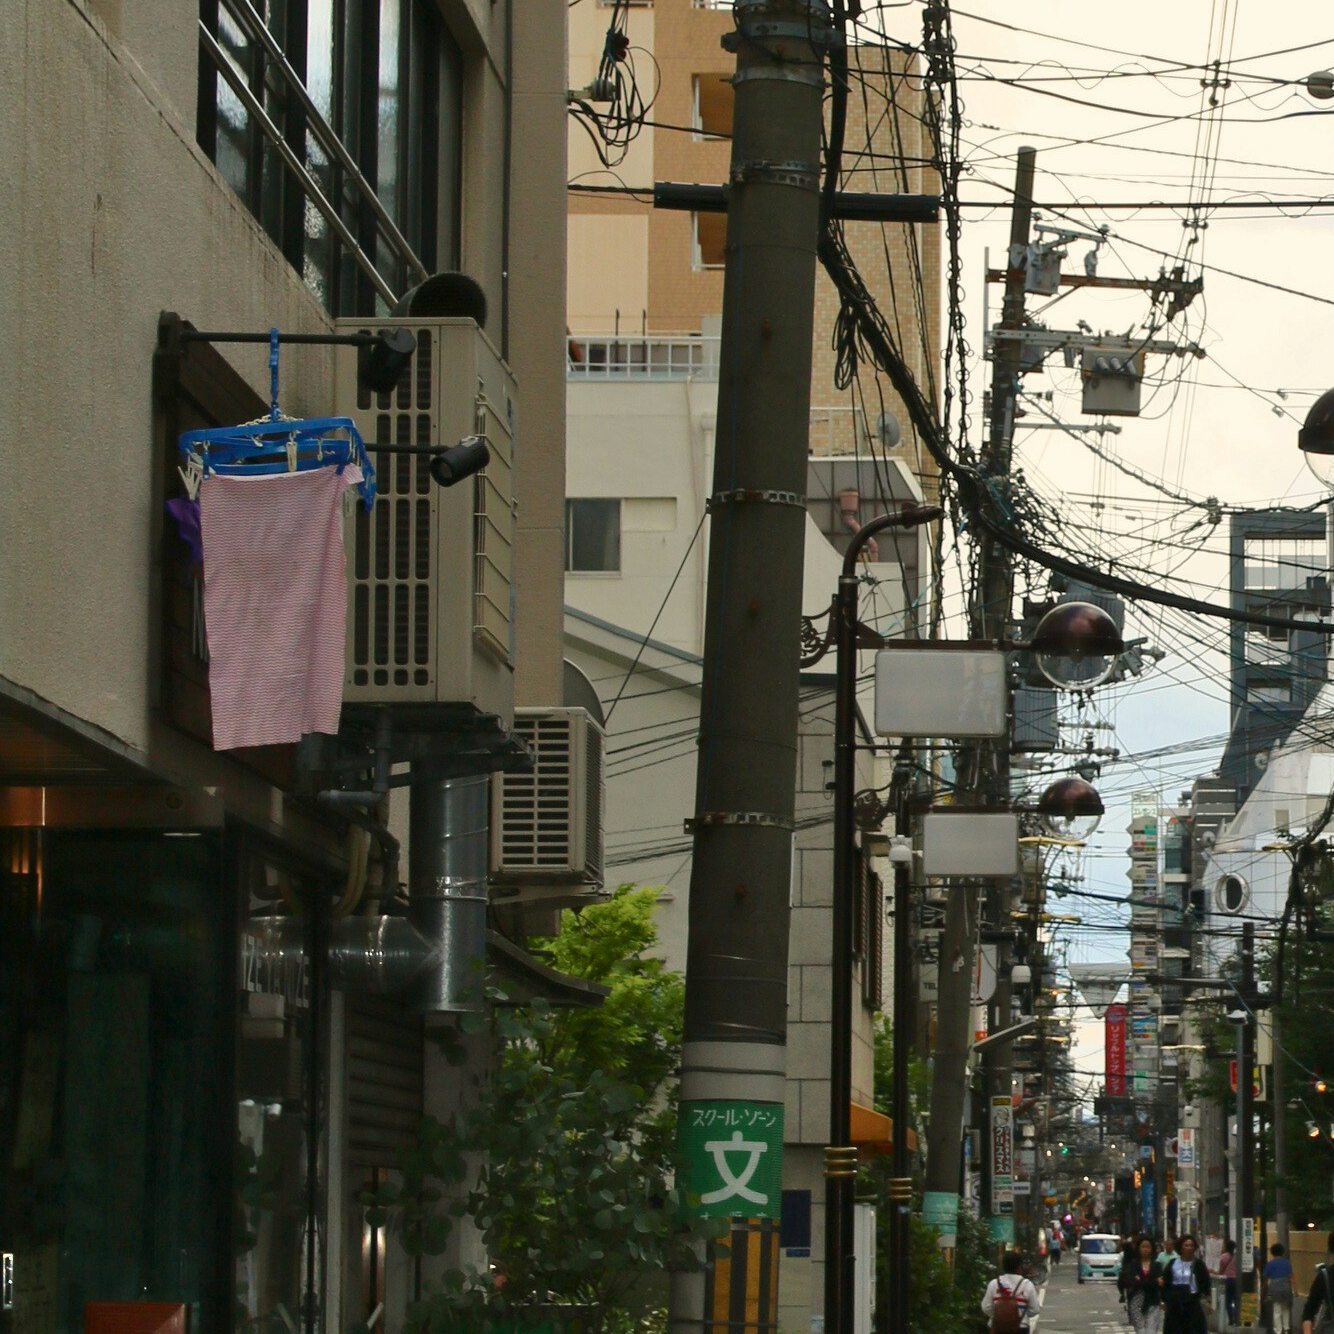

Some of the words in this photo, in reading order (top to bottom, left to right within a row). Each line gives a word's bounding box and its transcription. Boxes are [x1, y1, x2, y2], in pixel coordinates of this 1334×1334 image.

[692, 1108, 777, 1128] スクール・ゾーン
[700, 1130, 769, 1205] 文
